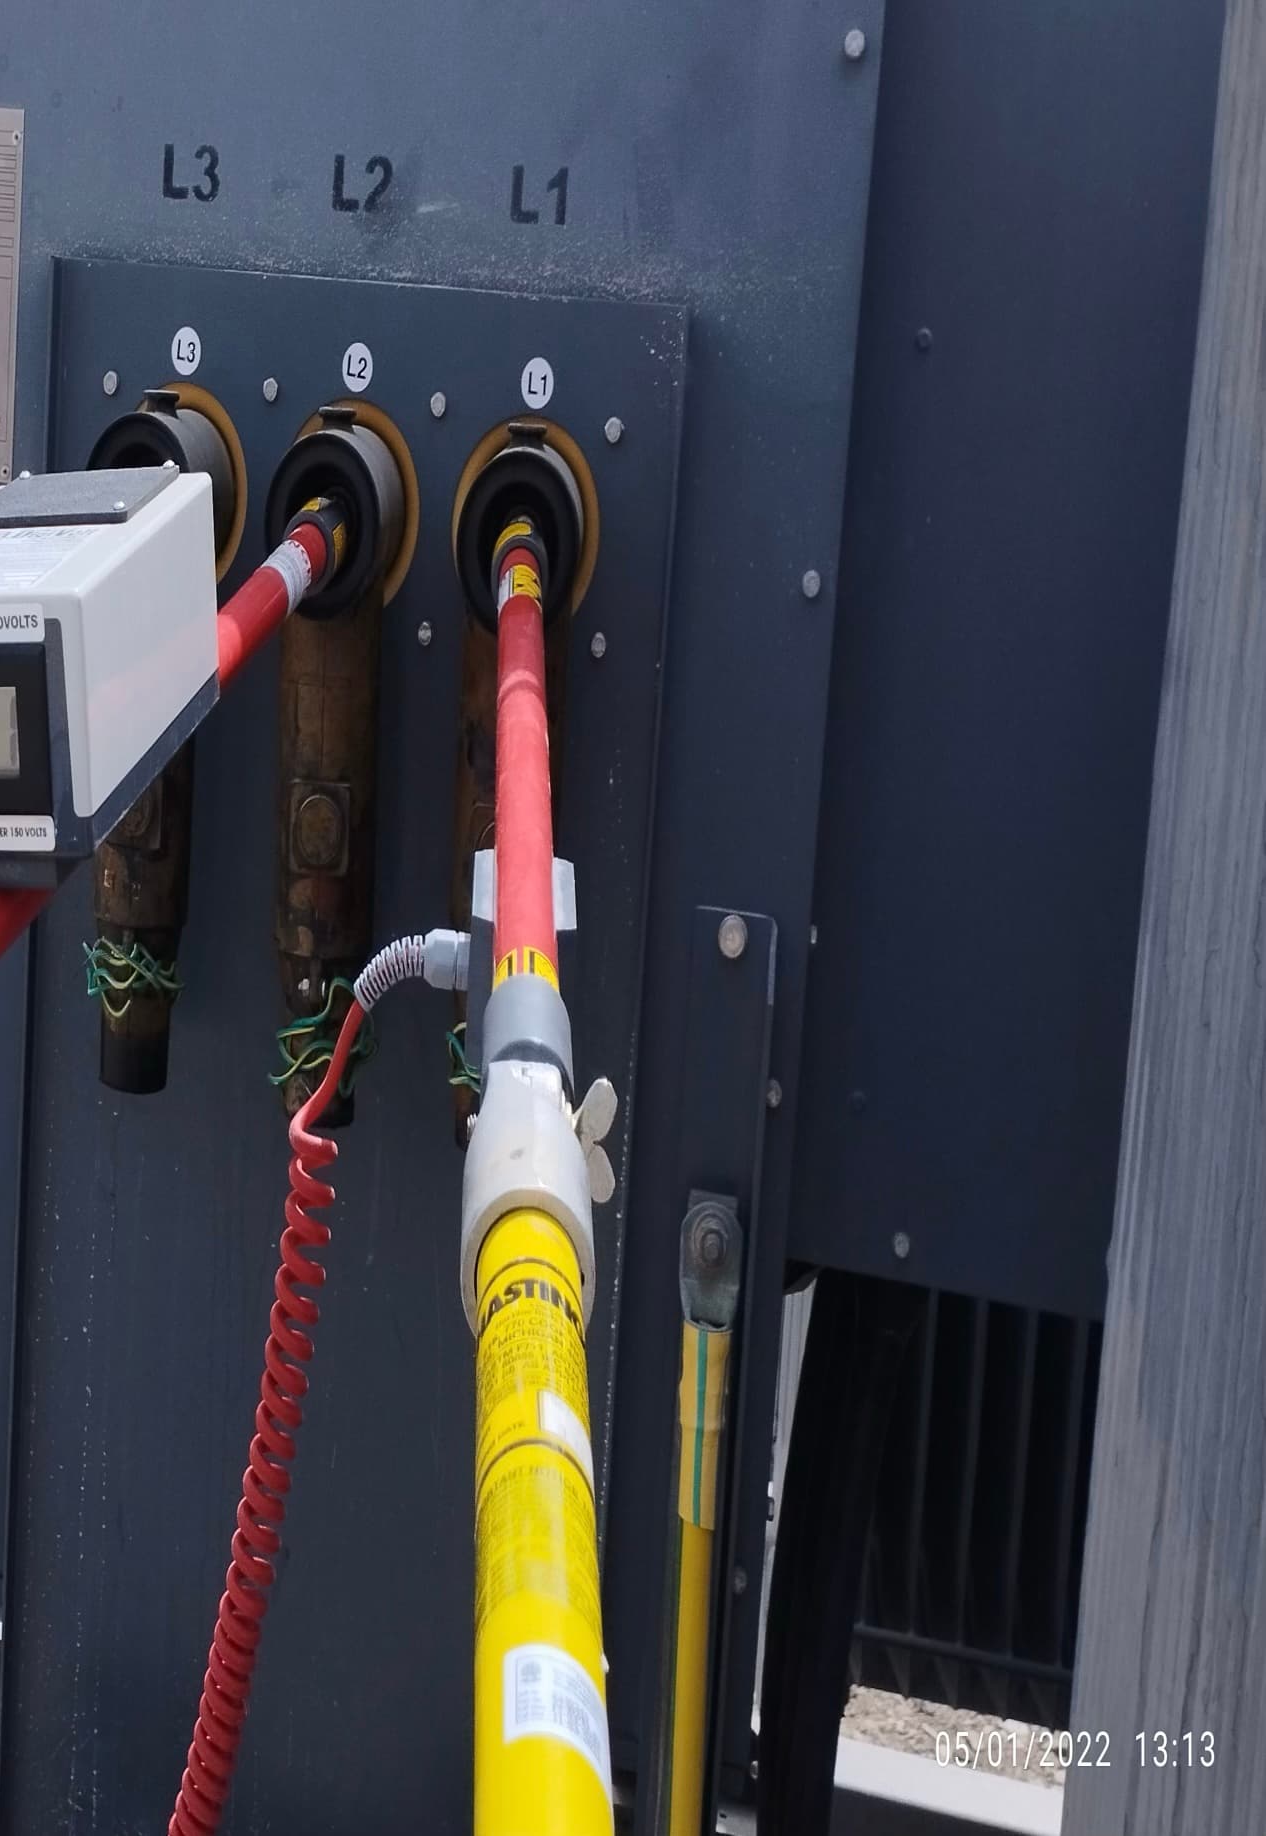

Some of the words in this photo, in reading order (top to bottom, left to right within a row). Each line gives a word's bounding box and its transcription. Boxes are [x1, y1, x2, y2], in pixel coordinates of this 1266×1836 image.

[162, 143, 221, 202] L3
[331, 153, 394, 213] L2
[509, 164, 570, 226] L1
[176, 338, 196, 362] L3
[346, 356, 368, 380] L2
[527, 371, 548, 396] L1
[10, 828, 24, 838] 150
[25, 827, 47, 838] VOLTS
